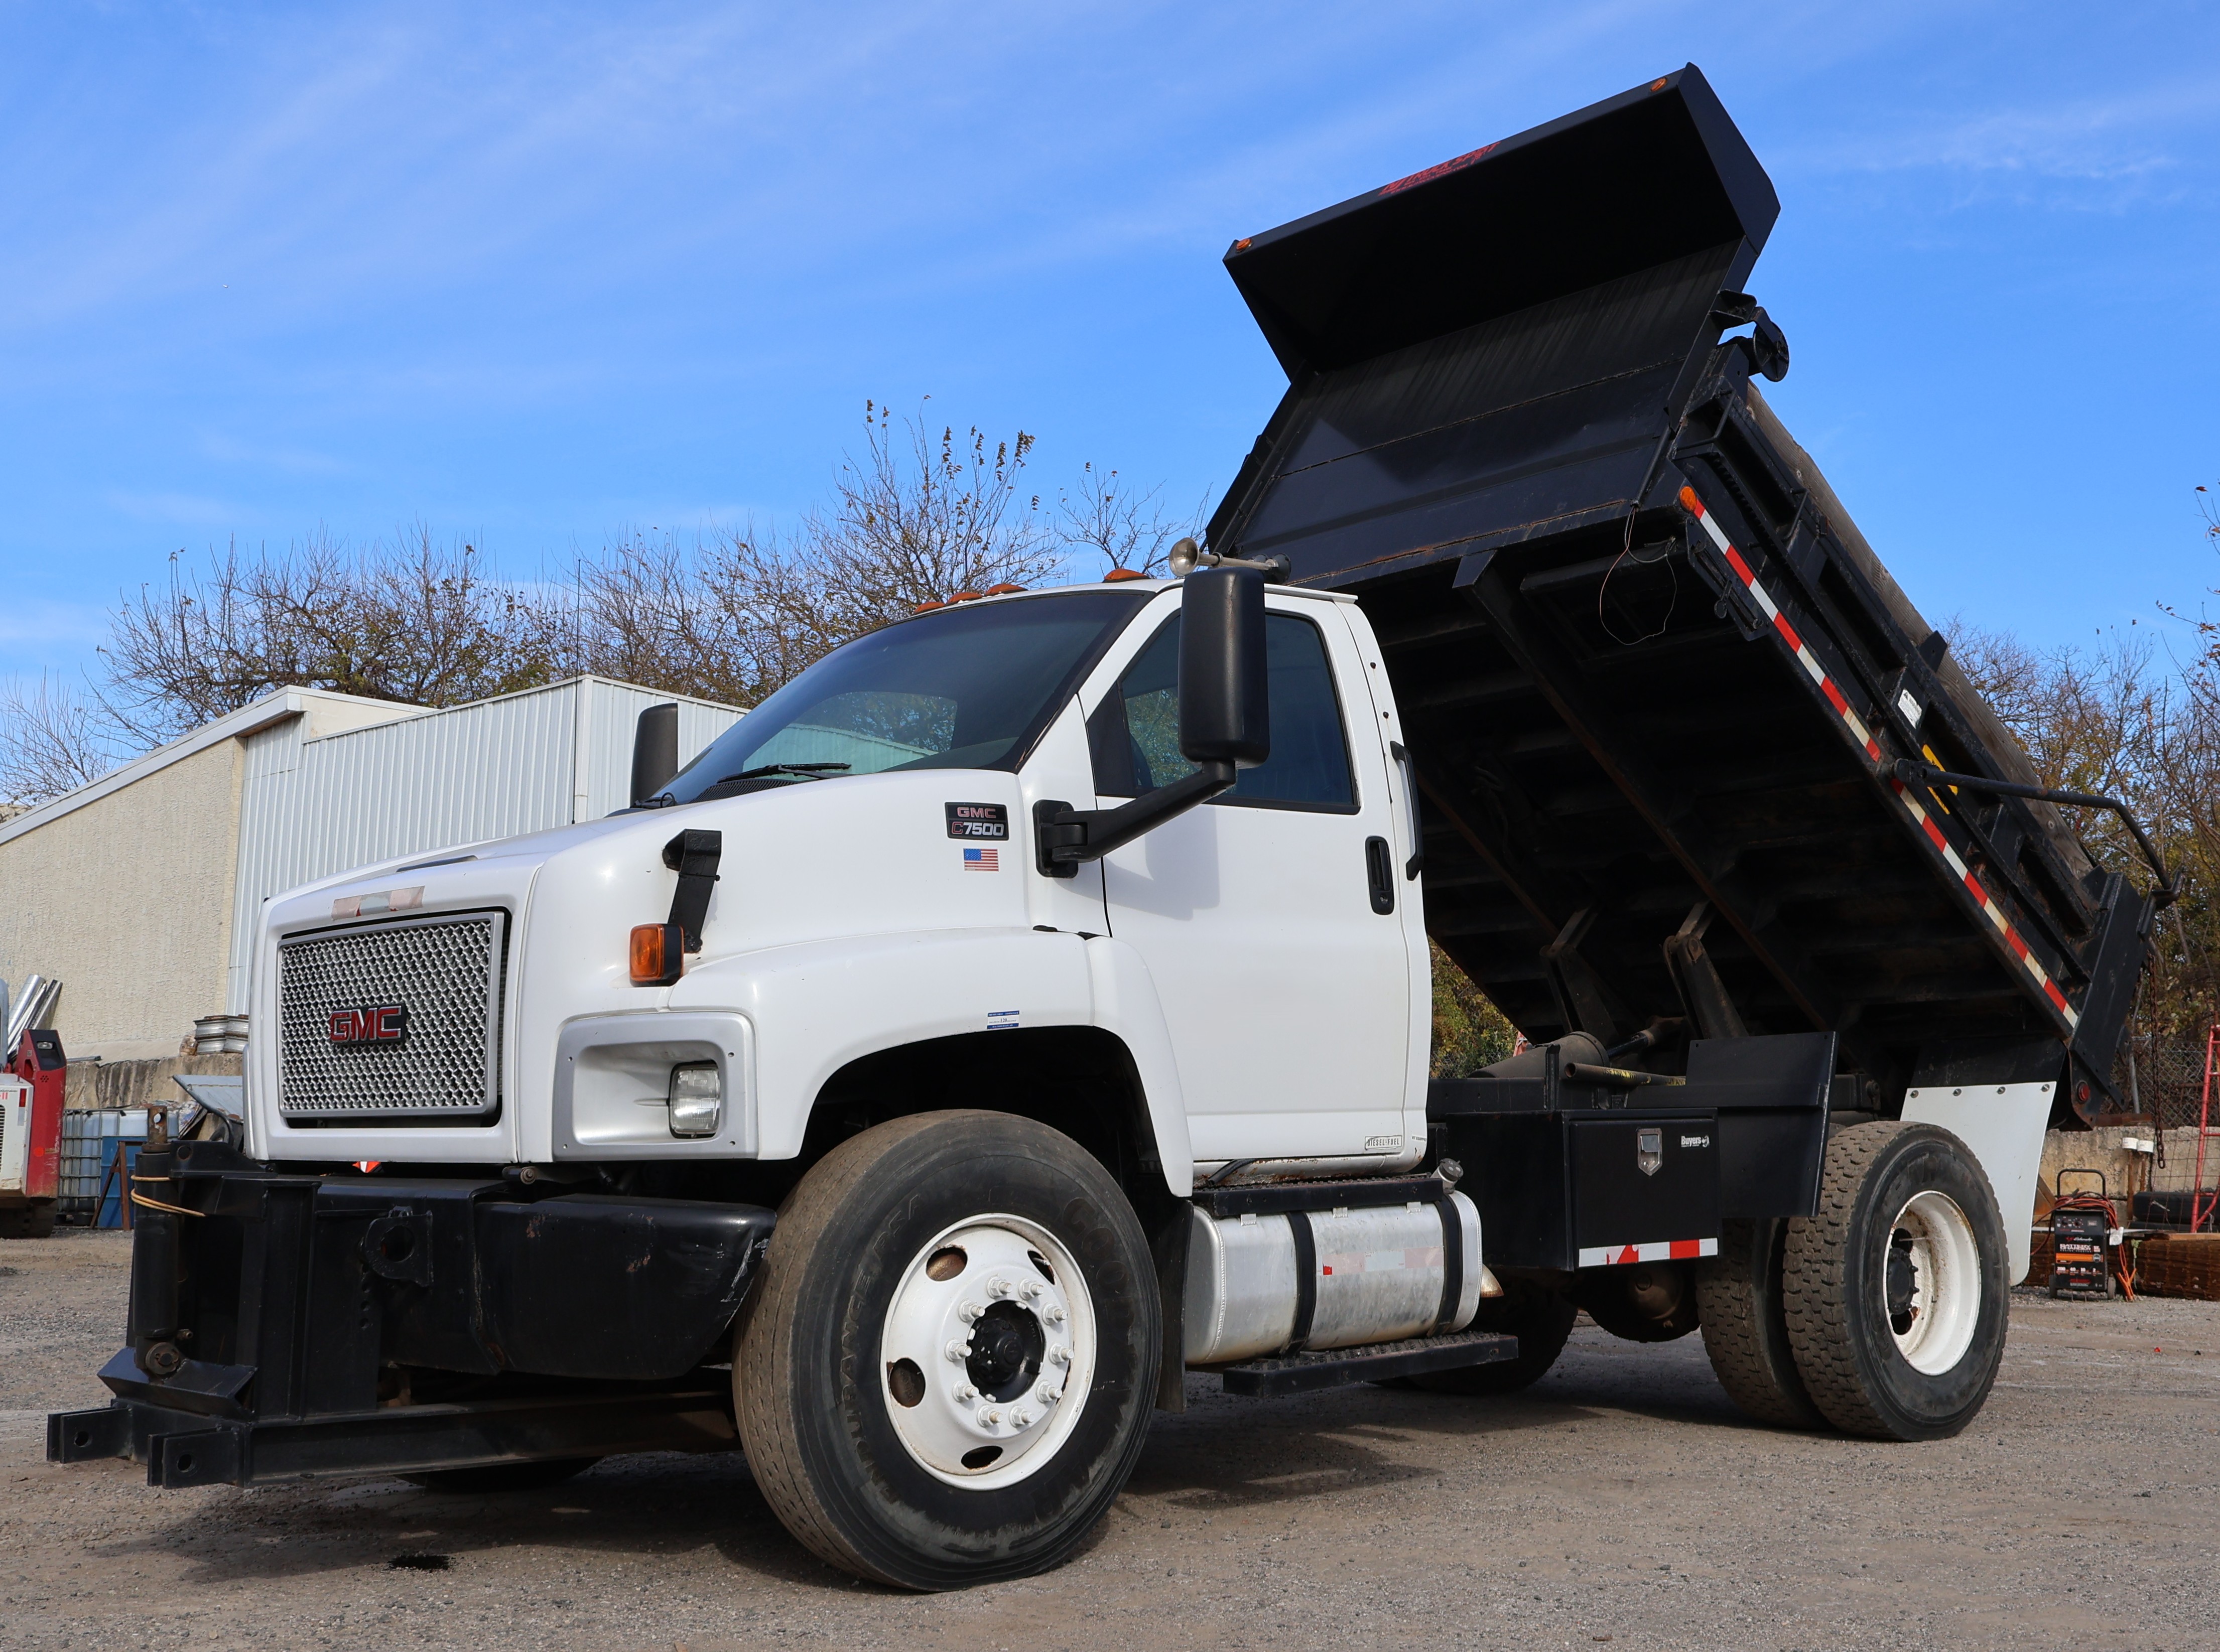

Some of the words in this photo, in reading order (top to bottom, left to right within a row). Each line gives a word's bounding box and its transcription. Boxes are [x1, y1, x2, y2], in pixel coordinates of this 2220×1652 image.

[957, 807, 997, 818] GMC
[951, 821, 1004, 836] C7500
[330, 1006, 402, 1043] GMC
[1367, 1139, 1385, 1147] DIESEL
[1681, 1136, 1701, 1147] Buyers
